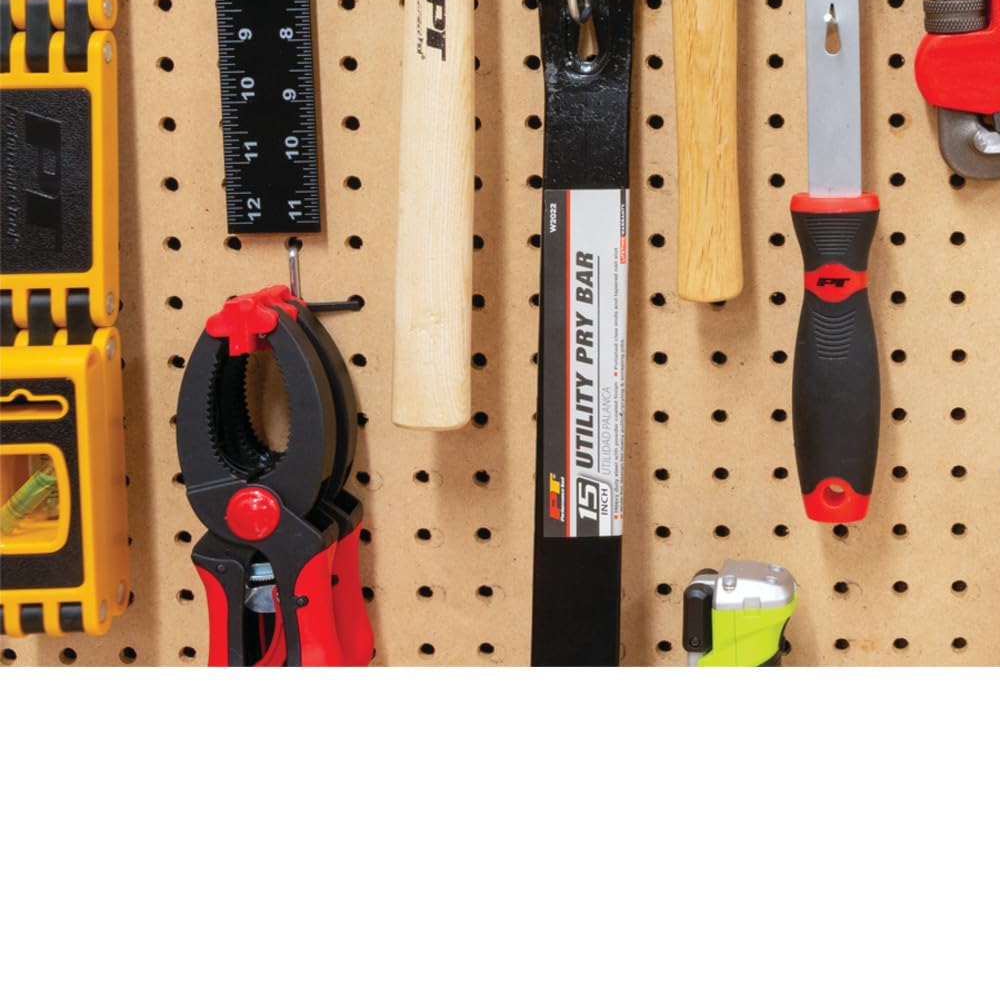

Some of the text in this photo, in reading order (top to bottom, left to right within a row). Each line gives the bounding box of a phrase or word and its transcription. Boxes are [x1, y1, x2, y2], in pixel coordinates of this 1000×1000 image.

[238, 28, 252, 41] 9
[279, 27, 294, 39] 8
[240, 77, 255, 101] 10
[282, 88, 297, 101] 9
[244, 142, 258, 161] 11
[284, 136, 299, 160] 10
[247, 197, 261, 221] 12
[287, 200, 302, 220] 11
[550, 203, 558, 234] W2022
[815, 277, 851, 289] PT
[576, 250, 595, 469] UTILITY PRY BAR
[601, 386, 611, 476] UTILIDAD PALANCA
[549, 472, 561, 521] PT
[577, 476, 599, 522] 15
[600, 488, 609, 516] INCH
